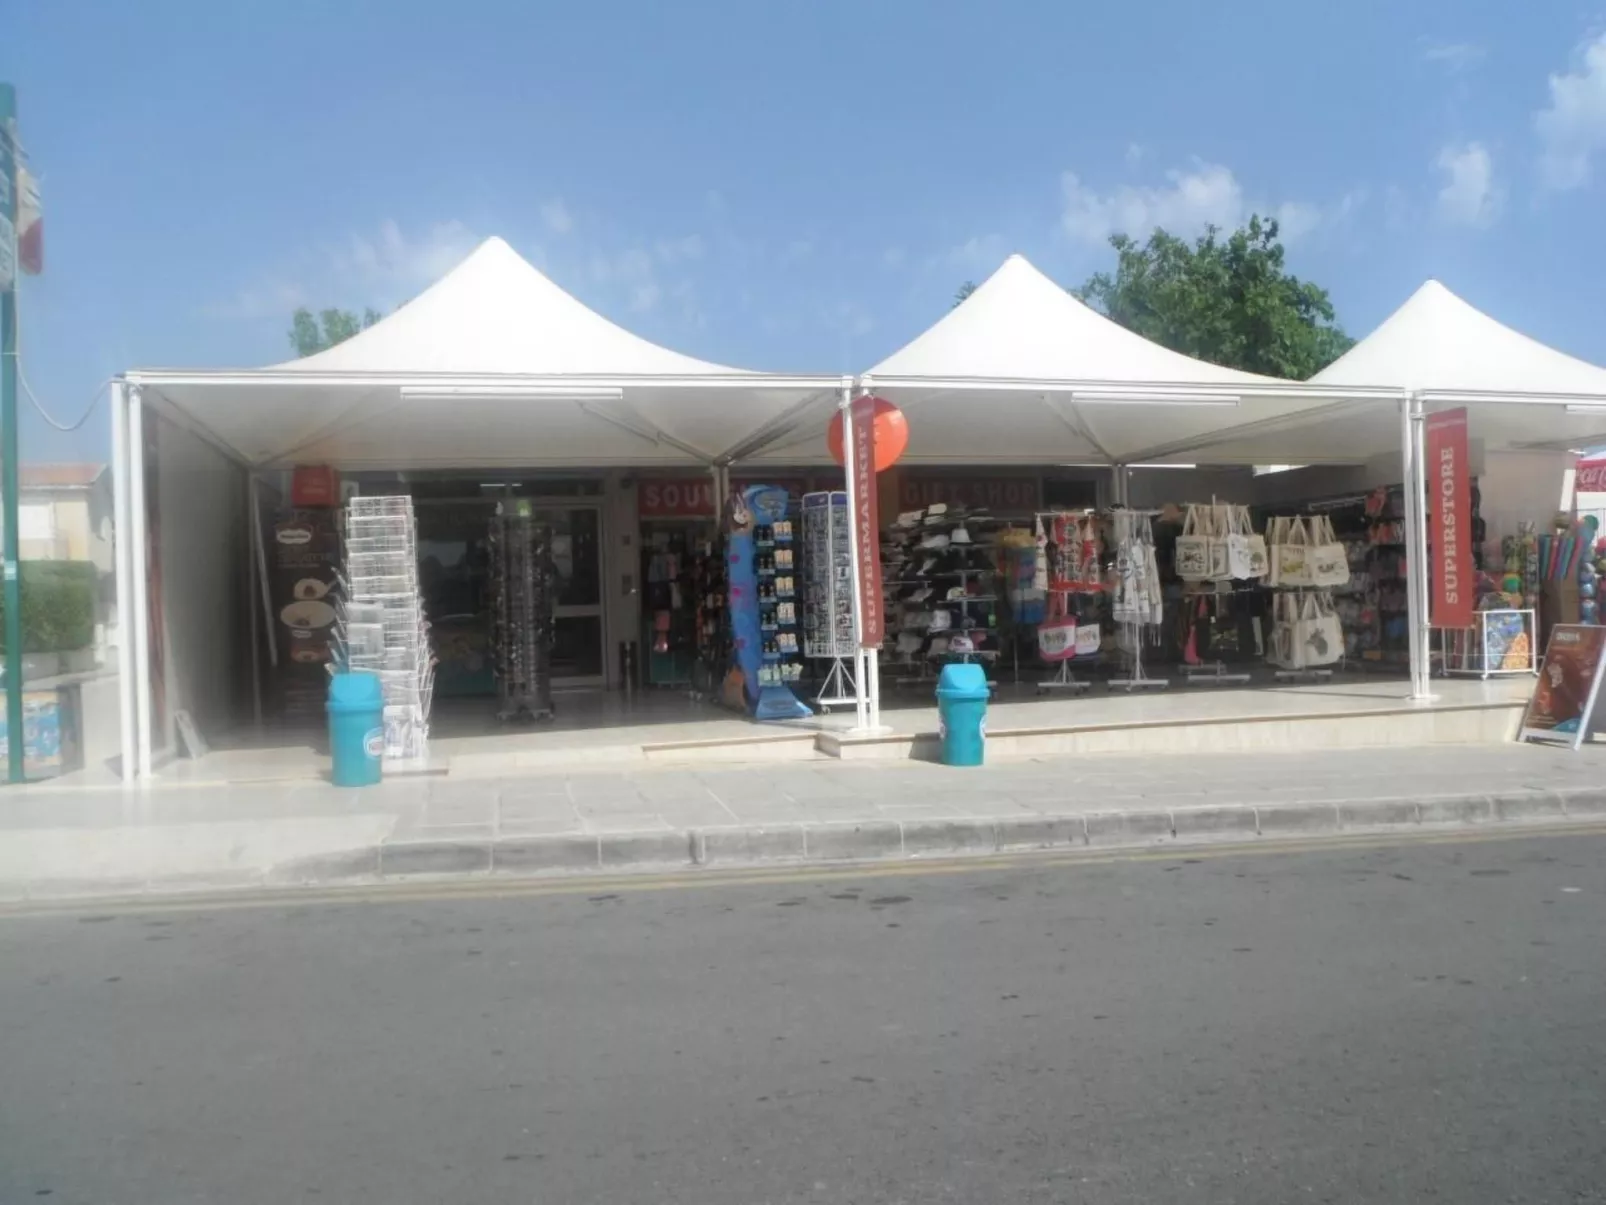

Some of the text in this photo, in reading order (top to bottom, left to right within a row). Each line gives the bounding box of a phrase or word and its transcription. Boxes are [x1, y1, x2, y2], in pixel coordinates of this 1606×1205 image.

[858, 426, 877, 635] SUPERMARKET
[905, 481, 1035, 504] GIFT SHOP
[1441, 447, 1459, 604] SUPERSTORE
